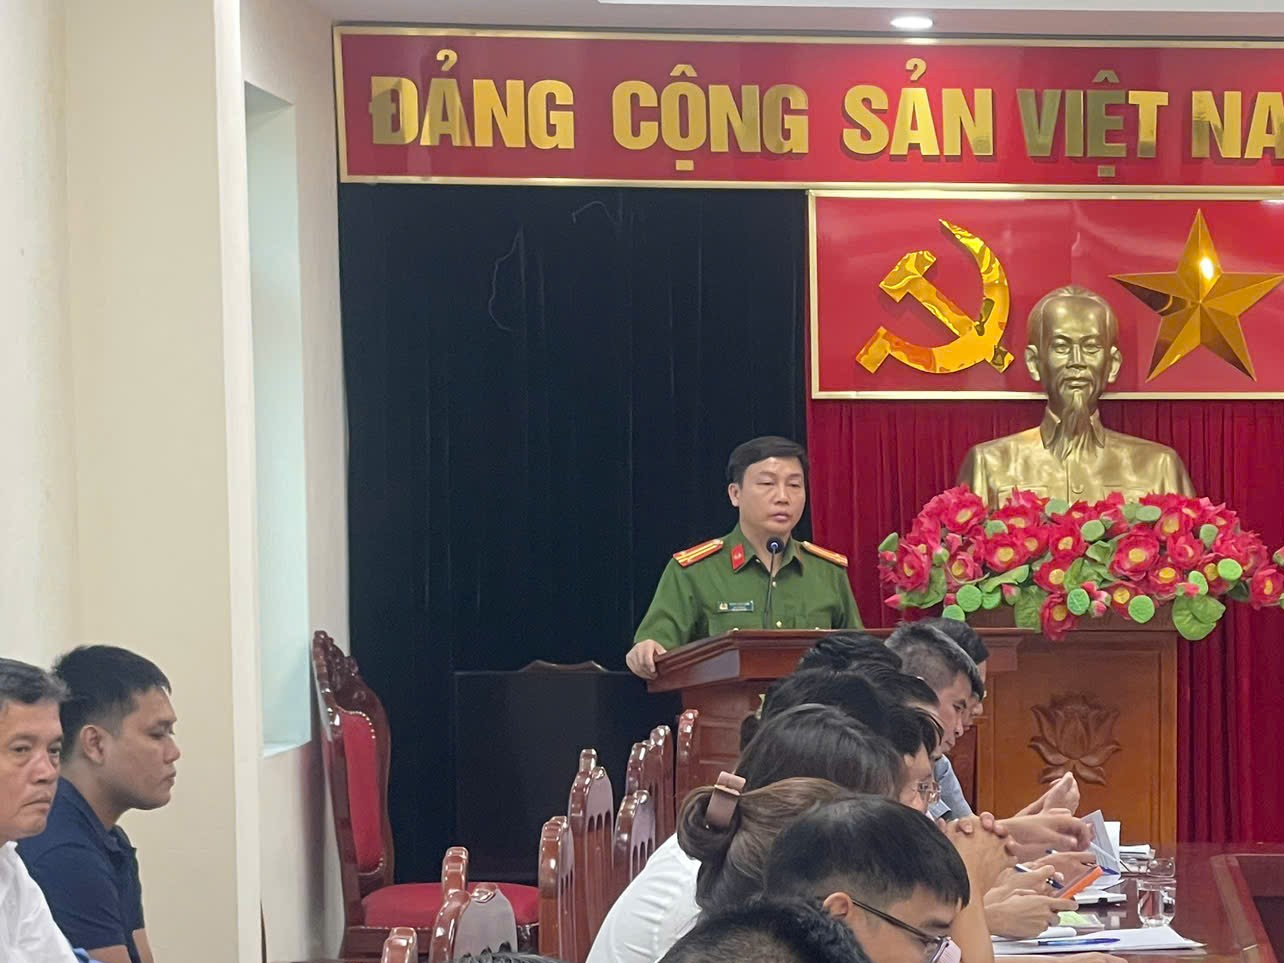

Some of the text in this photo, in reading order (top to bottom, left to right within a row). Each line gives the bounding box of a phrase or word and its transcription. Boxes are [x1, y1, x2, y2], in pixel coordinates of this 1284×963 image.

[369, 49, 574, 150] ĐẢNG
[611, 64, 809, 171] CỘNG
[842, 58, 994, 158] SẢN
[1017, 70, 1168, 177] VIỆT
